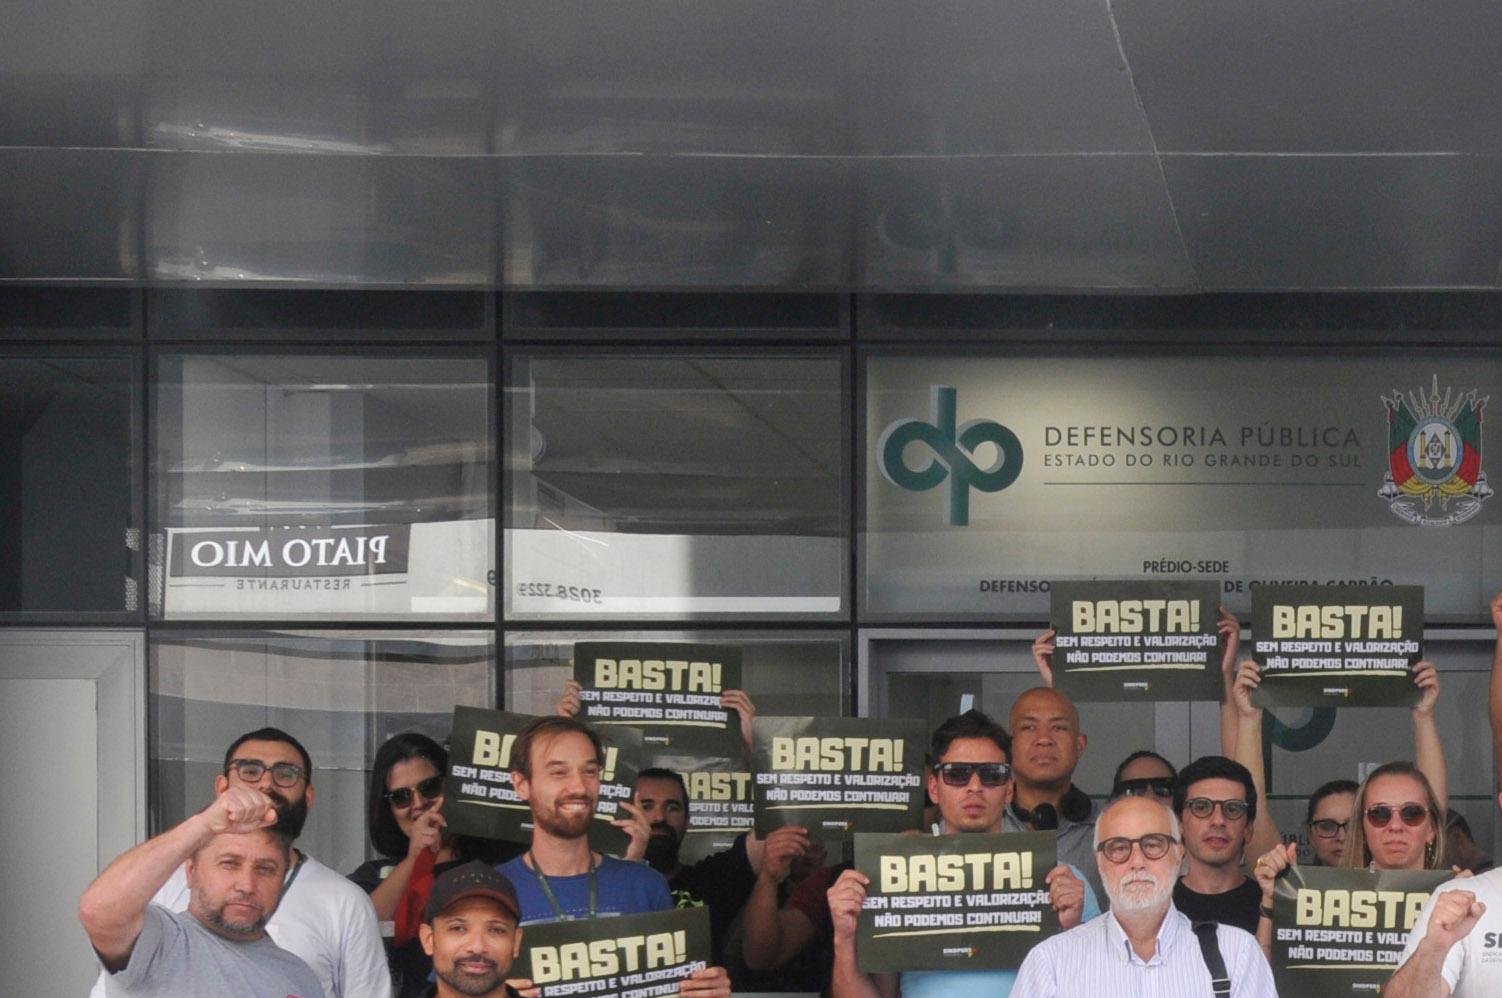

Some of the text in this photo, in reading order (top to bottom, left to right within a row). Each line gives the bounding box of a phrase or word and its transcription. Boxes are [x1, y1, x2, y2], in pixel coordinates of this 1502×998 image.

[1045, 421, 1361, 447] DEFENSORIA PÚBLICA
[1044, 454, 1361, 467] ESTADO DO RIO GRANDE DO SUL
[1143, 557, 1229, 573] PRÉDIO-SEDE
[980, 581, 1050, 593] DEFENSO
[1224, 581, 1245, 593] DE
[1072, 600, 1199, 632] BASTA!
[1273, 605, 1402, 638] BASTA!
[1056, 634, 1216, 649] SEM RESPEITO VALORIZAÇÃO
[1256, 640, 1418, 655] SEM RESPEITO VALORIZAÇÃO
[1067, 651, 1206, 663] NÃO PODEMOS CONTINUAR!
[1266, 656, 1408, 668] NÃO PODEMOS CONTINUAR!
[595, 659, 721, 692] BASTA!
[603, 691, 652, 702] RESPEITO
[588, 704, 728, 721] NÃO PODEMOS CONTINUAR!
[773, 737, 904, 771] BASTA!
[452, 765, 477, 778] SEM
[757, 773, 920, 788] SEM RESPEITO VALORIZAÇÃO
[462, 783, 487, 796] NÃO
[767, 788, 909, 802] NÃO PODEMOS CONTINUAR!
[881, 852, 1033, 893] BASTA!
[891, 895, 950, 908] RESPEITO
[1296, 889, 1430, 929] BASTA
[875, 911, 1041, 927] NÃO PODEMOS CONTINUAR!
[1277, 929, 1362, 943] SEM RESPEITO
[530, 930, 687, 984] BASTA!
[1289, 945, 1313, 960] NÃO
[1317, 948, 1373, 962] PODEMOS
[544, 978, 606, 997] RESPEITO
